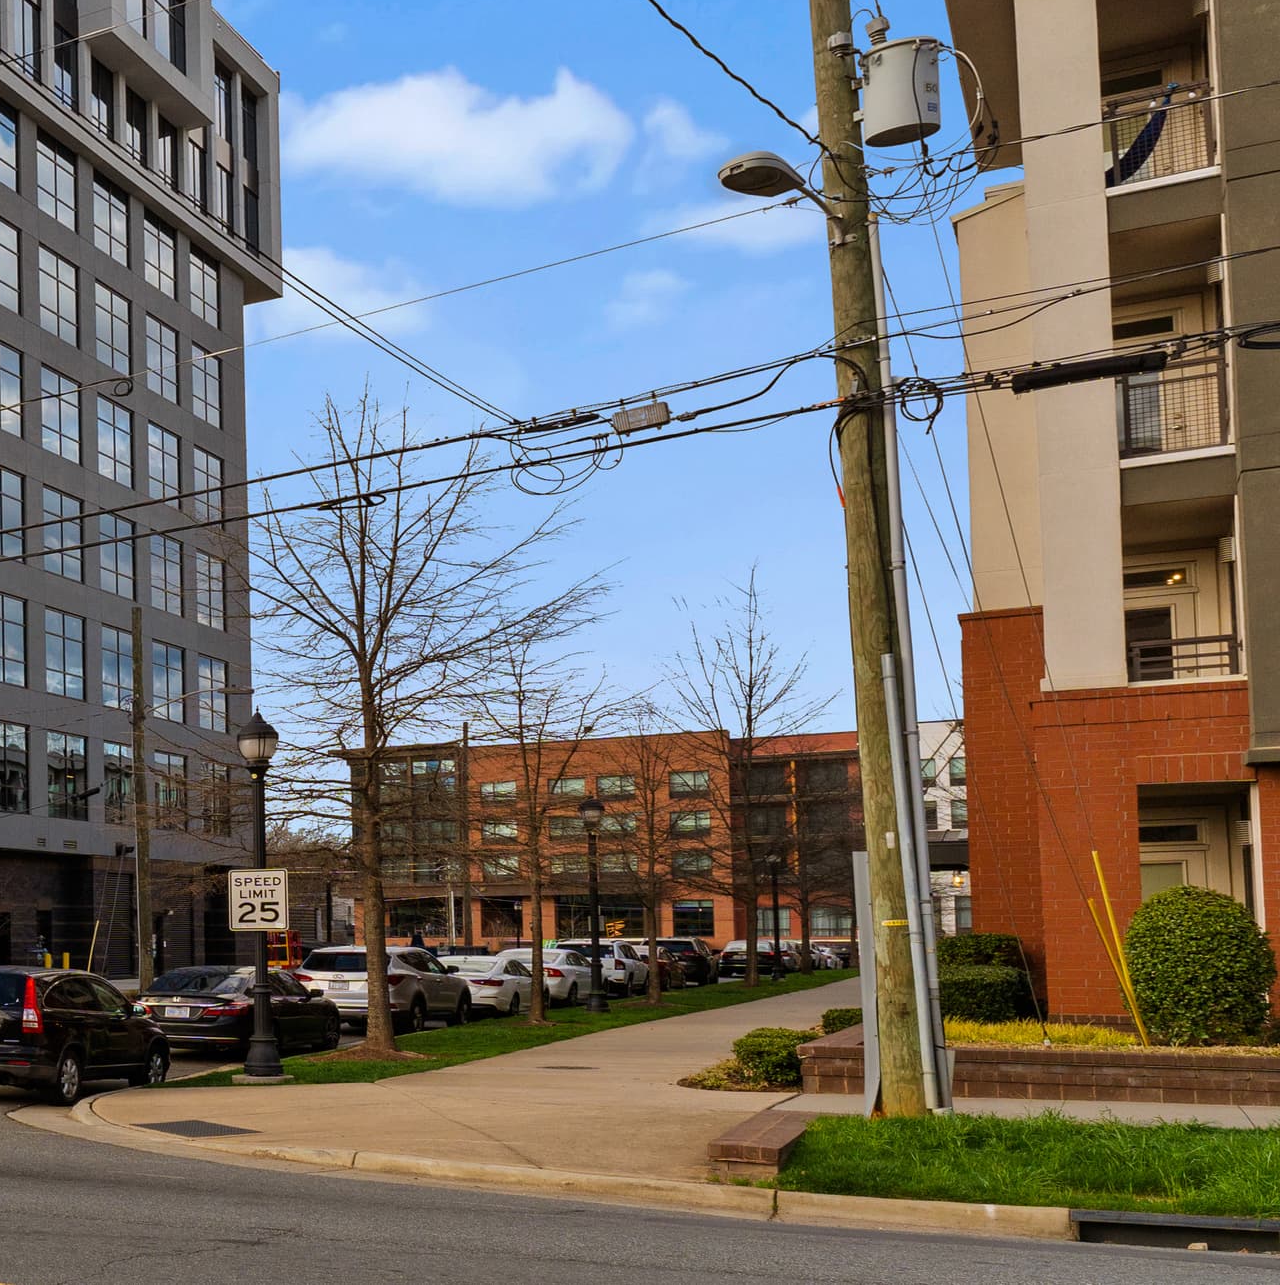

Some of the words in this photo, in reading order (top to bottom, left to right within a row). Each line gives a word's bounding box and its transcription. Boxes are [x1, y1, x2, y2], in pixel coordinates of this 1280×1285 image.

[234, 877, 281, 886] SPEED
[240, 889, 276, 898] LIMIT
[238, 902, 279, 923] 25
